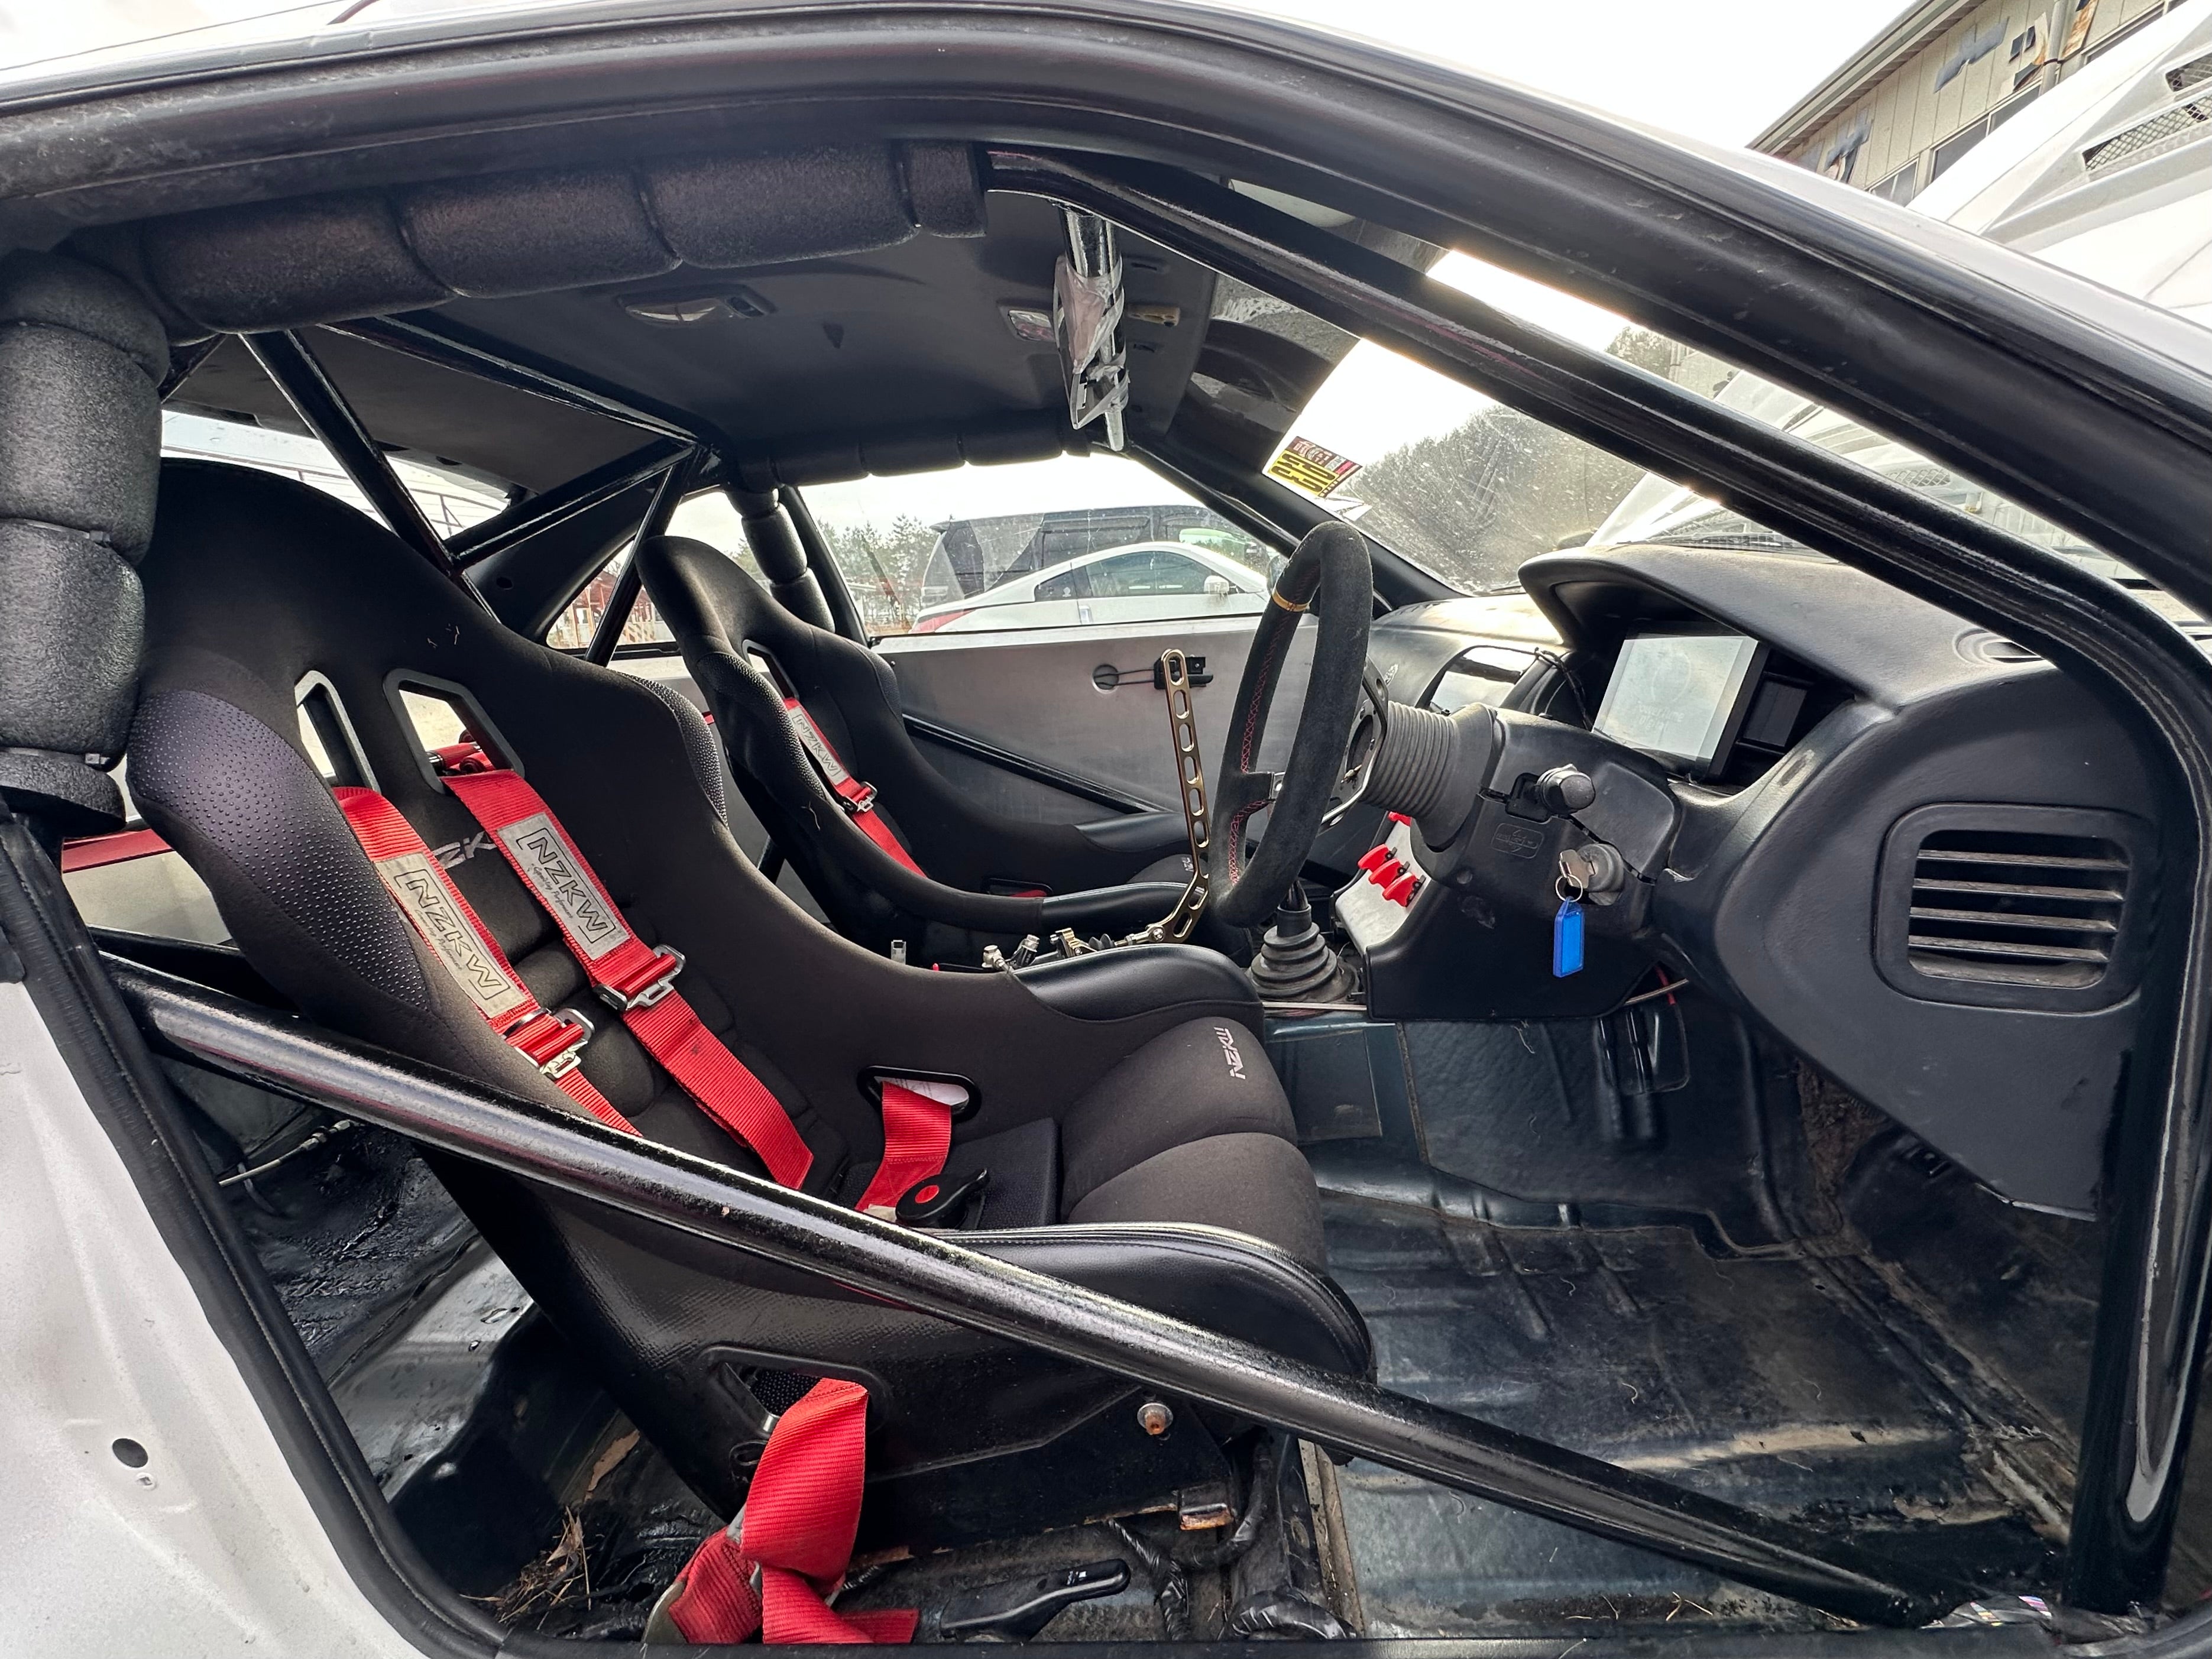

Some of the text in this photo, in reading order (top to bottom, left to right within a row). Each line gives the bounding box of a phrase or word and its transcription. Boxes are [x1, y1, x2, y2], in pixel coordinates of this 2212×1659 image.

[796, 718, 838, 772] NZKW
[432, 830, 497, 869] ZK
[527, 837, 608, 932] NZKW
[405, 878, 502, 987] NZKW
